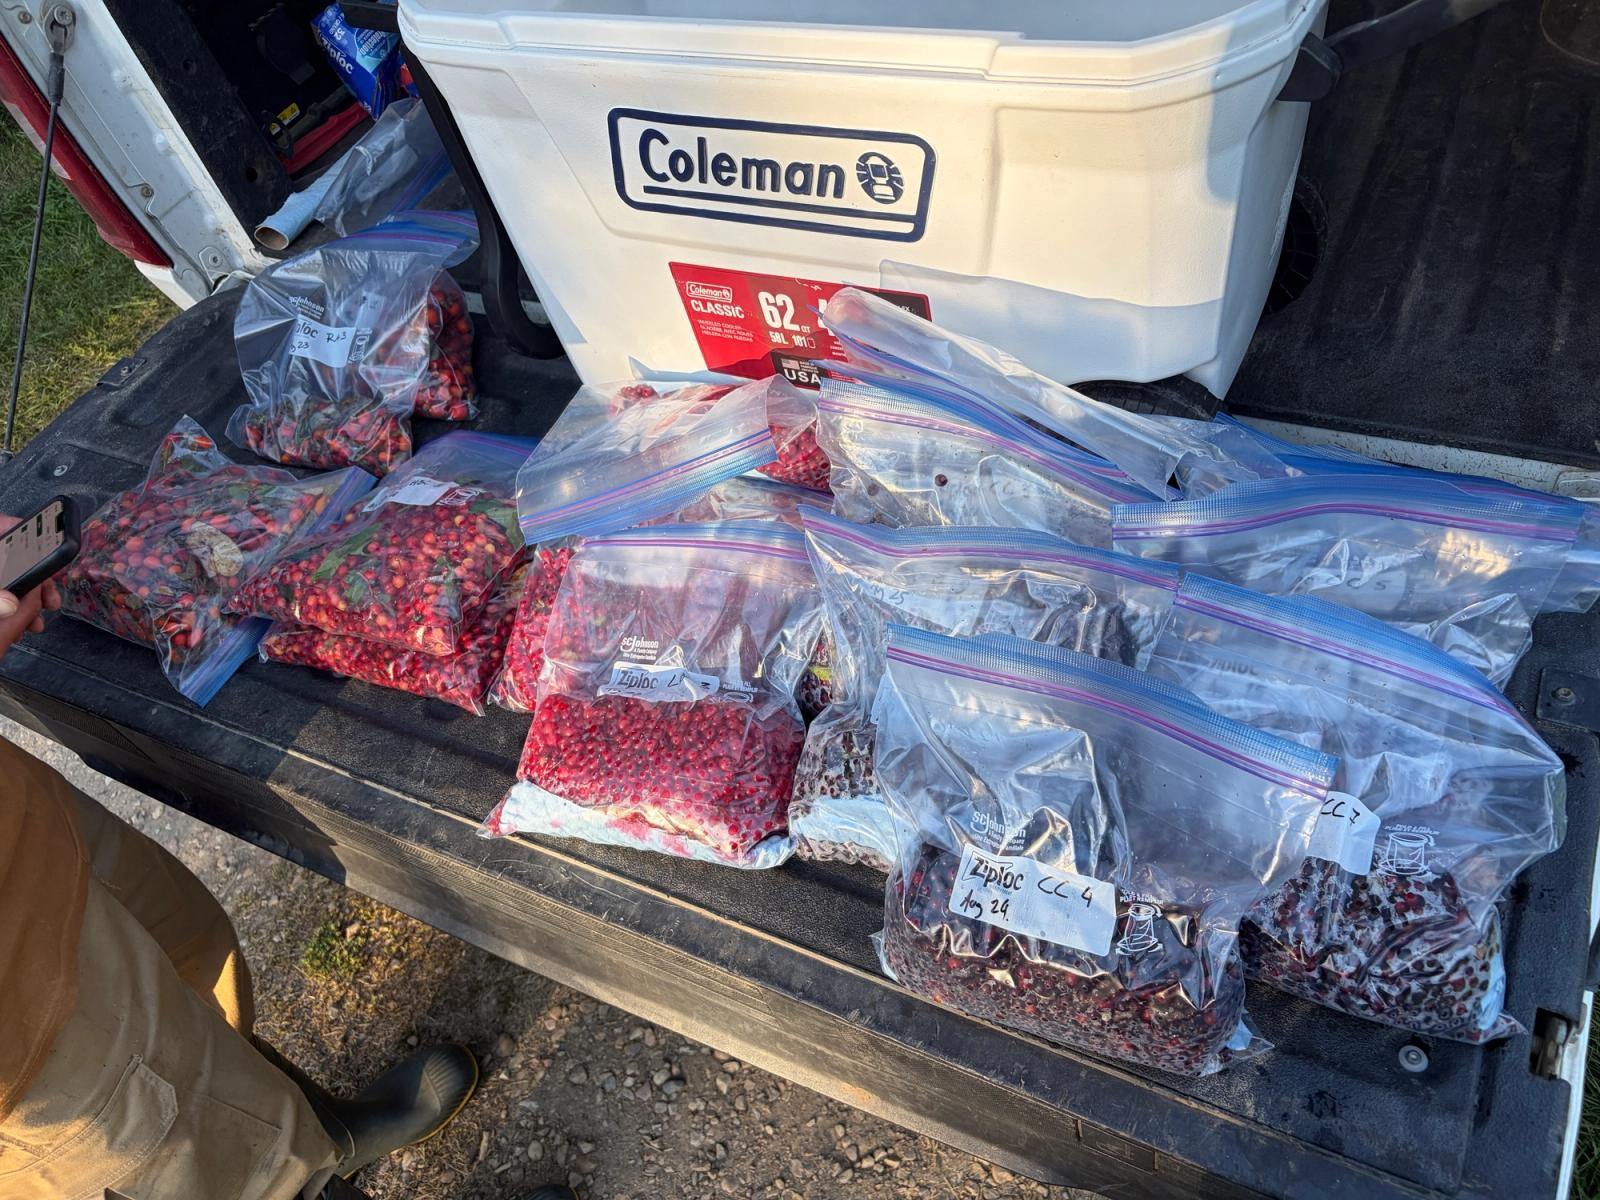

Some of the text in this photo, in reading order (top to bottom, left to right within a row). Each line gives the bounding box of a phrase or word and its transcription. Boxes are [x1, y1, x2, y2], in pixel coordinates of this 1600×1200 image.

[638, 128, 846, 199] Coleman
[690, 284, 723, 297] Coleman
[690, 299, 745, 319] CLASSIC
[758, 291, 801, 331] 62
[792, 335, 807, 348] 101
[784, 368, 821, 385] USA
[617, 671, 658, 690] Ziploc
[970, 857, 1024, 891] Ziploc
[1037, 876, 1070, 899] CC
[1081, 886, 1093, 908] 4
